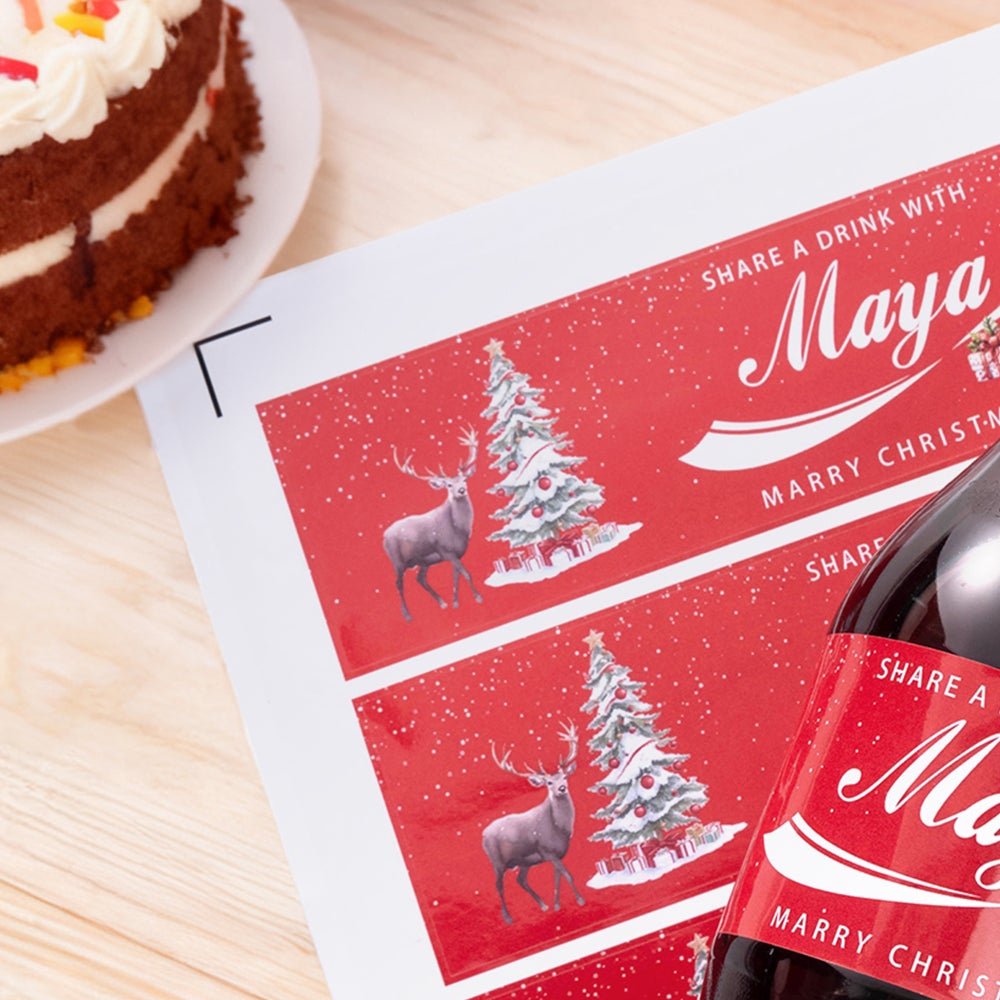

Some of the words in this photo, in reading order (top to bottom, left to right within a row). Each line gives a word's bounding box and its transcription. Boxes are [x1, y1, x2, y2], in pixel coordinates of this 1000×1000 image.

[701, 246, 784, 291] SHARE
[794, 239, 809, 260] A
[815, 207, 895, 251] DRINK
[900, 182, 967, 220] WITH
[738, 255, 991, 388] Maya
[761, 457, 861, 510] MARRY
[876, 657, 962, 699] SHARE
[968, 684, 986, 709] A
[769, 905, 873, 955] MARRY
